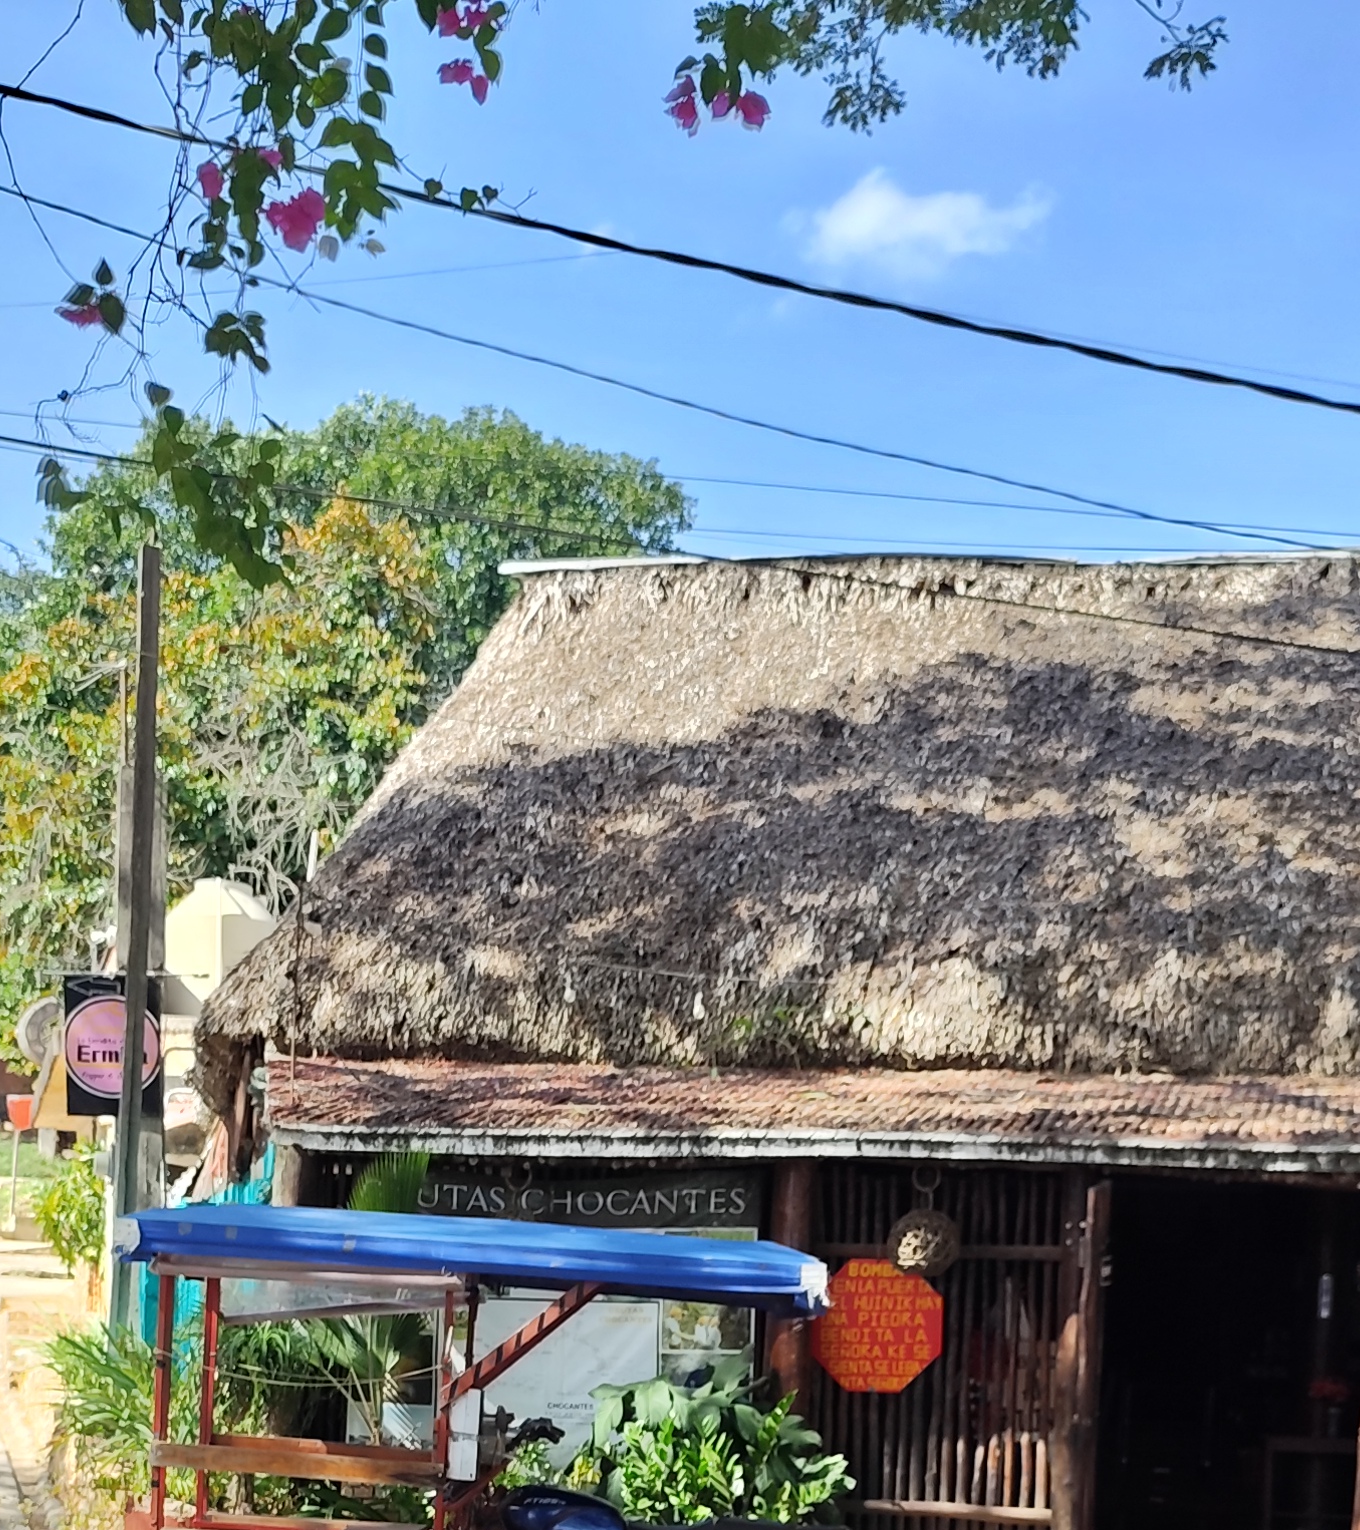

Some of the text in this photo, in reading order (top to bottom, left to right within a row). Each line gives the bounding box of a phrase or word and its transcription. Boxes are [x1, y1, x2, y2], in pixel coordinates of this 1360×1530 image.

[417, 1183, 747, 1216] UTAS CHOCANTES
[904, 1329, 928, 1343] LA
